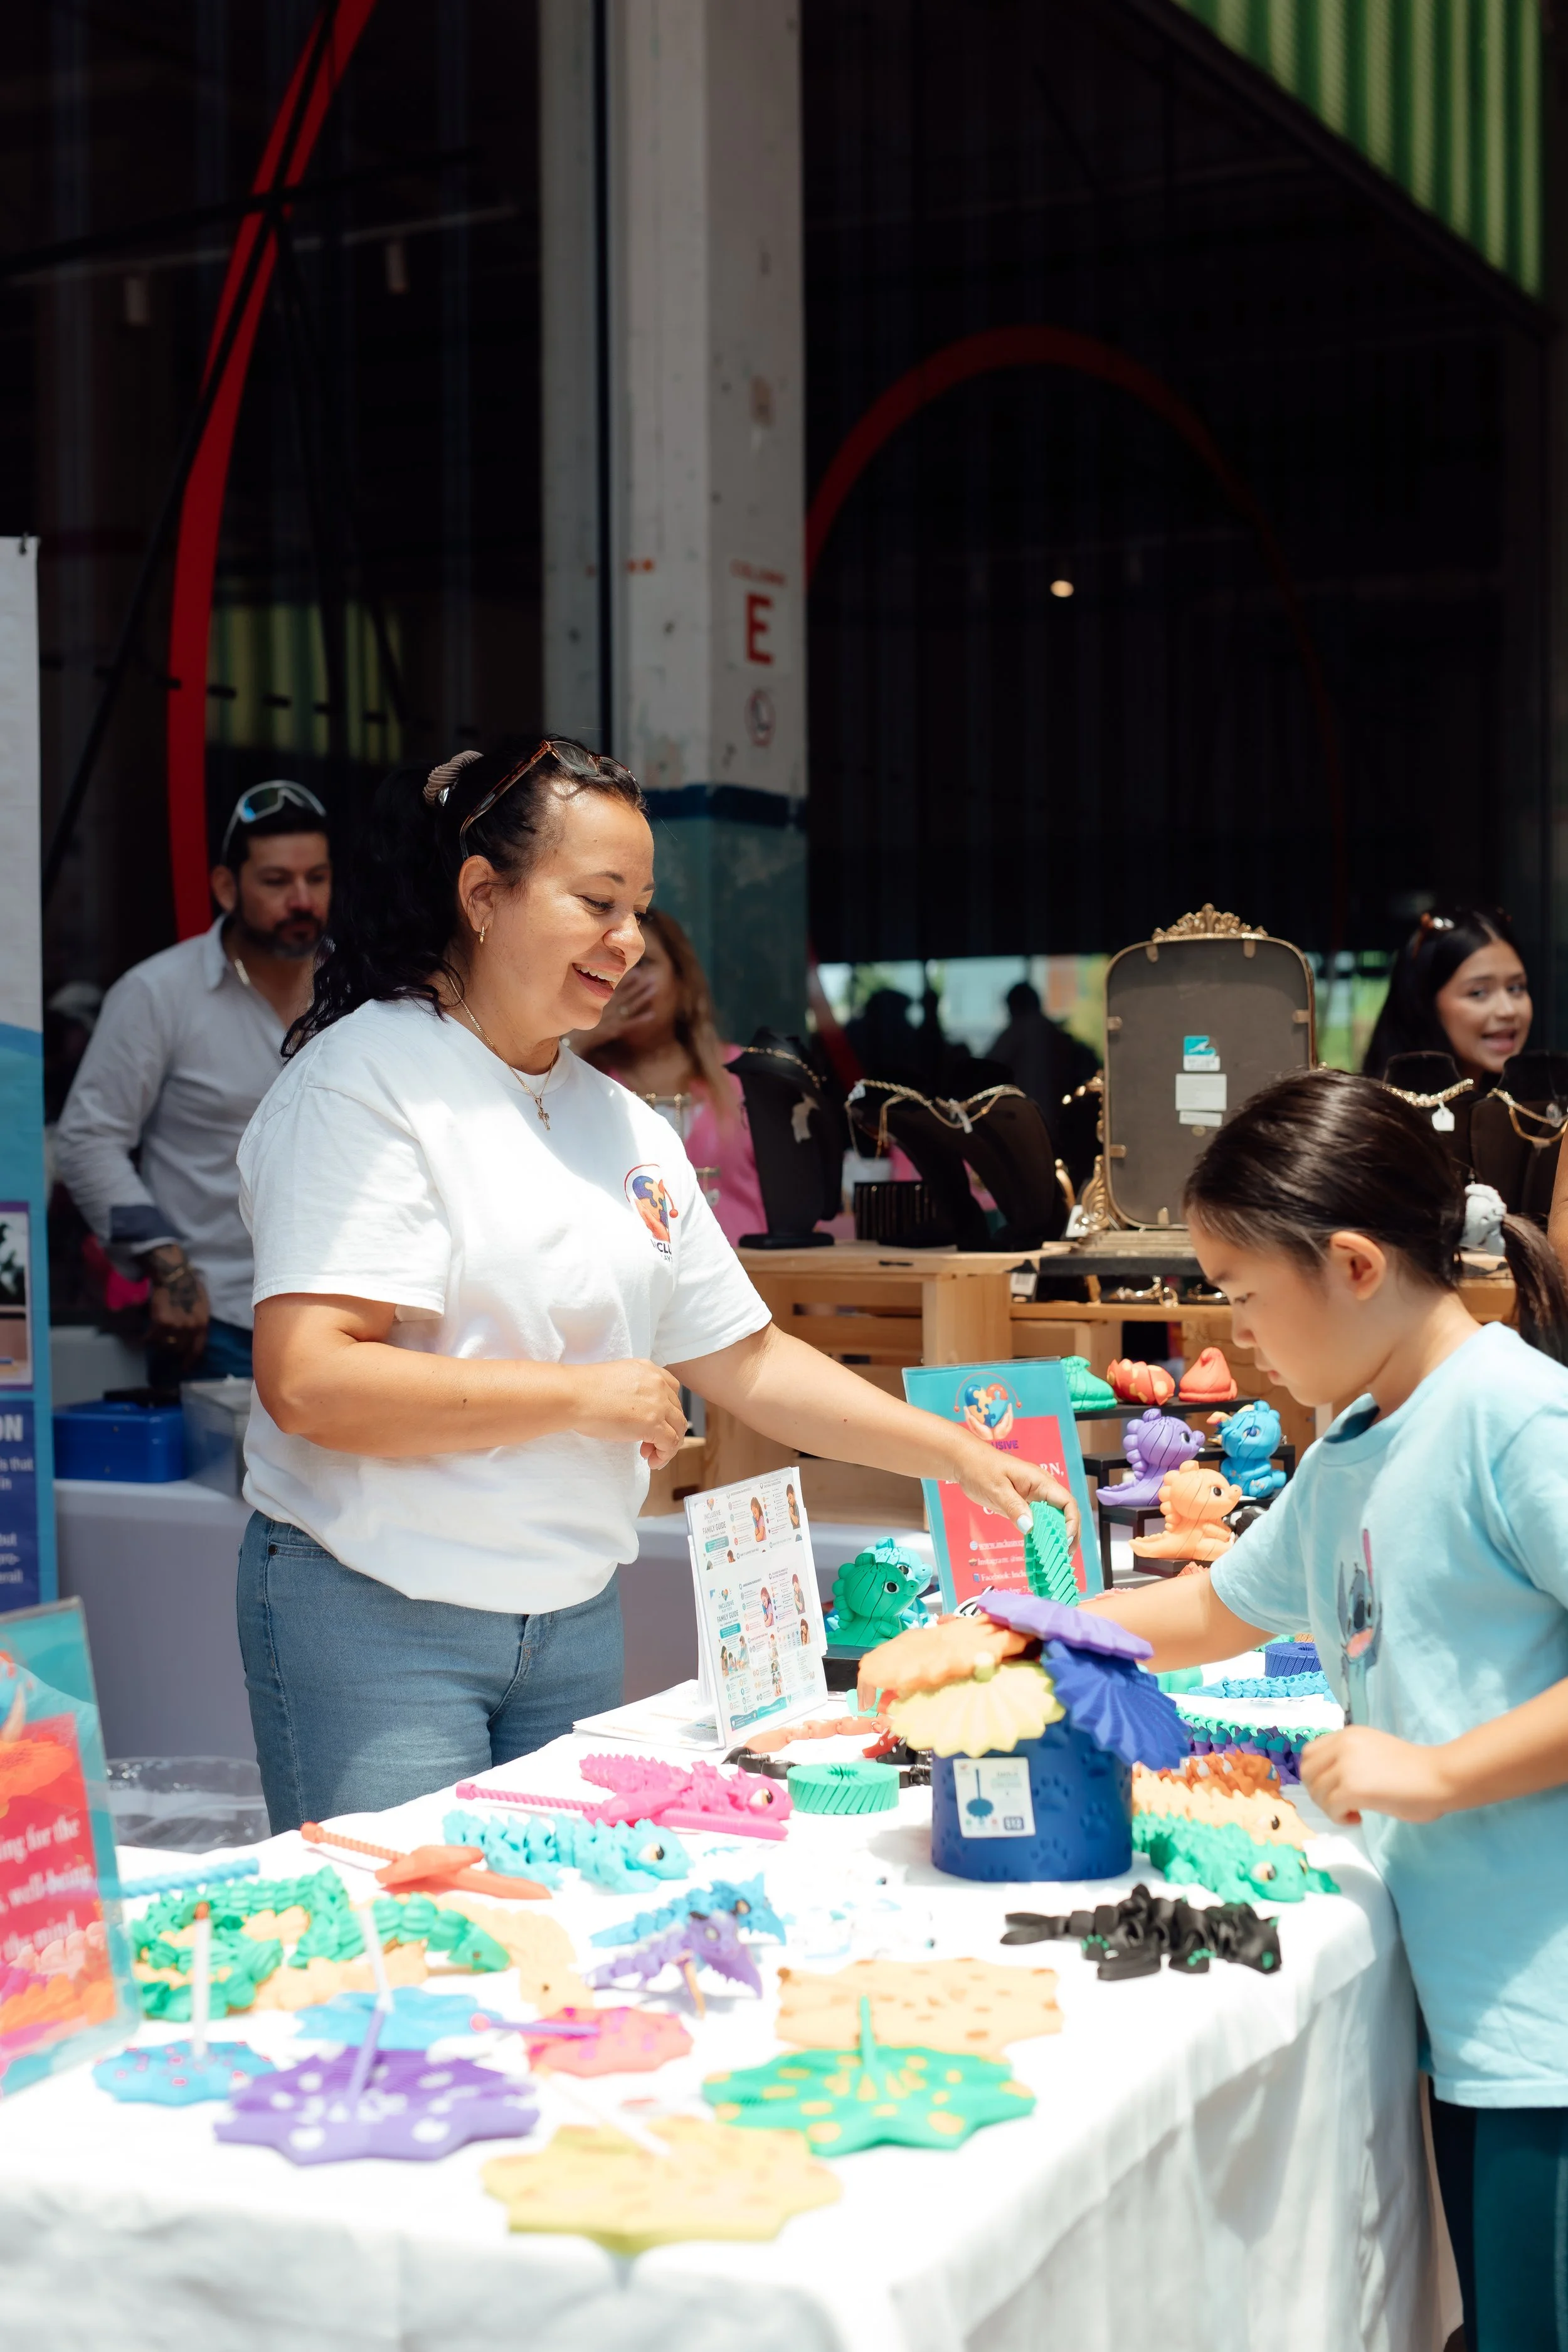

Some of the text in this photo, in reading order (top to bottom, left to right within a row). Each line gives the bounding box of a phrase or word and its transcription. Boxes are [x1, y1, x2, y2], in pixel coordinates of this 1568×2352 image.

[746, 592, 774, 666] E
[716, 1521, 726, 1530] GUIDE
[729, 1609, 739, 1619] GUIDE
[53, 1814, 80, 1844] the
